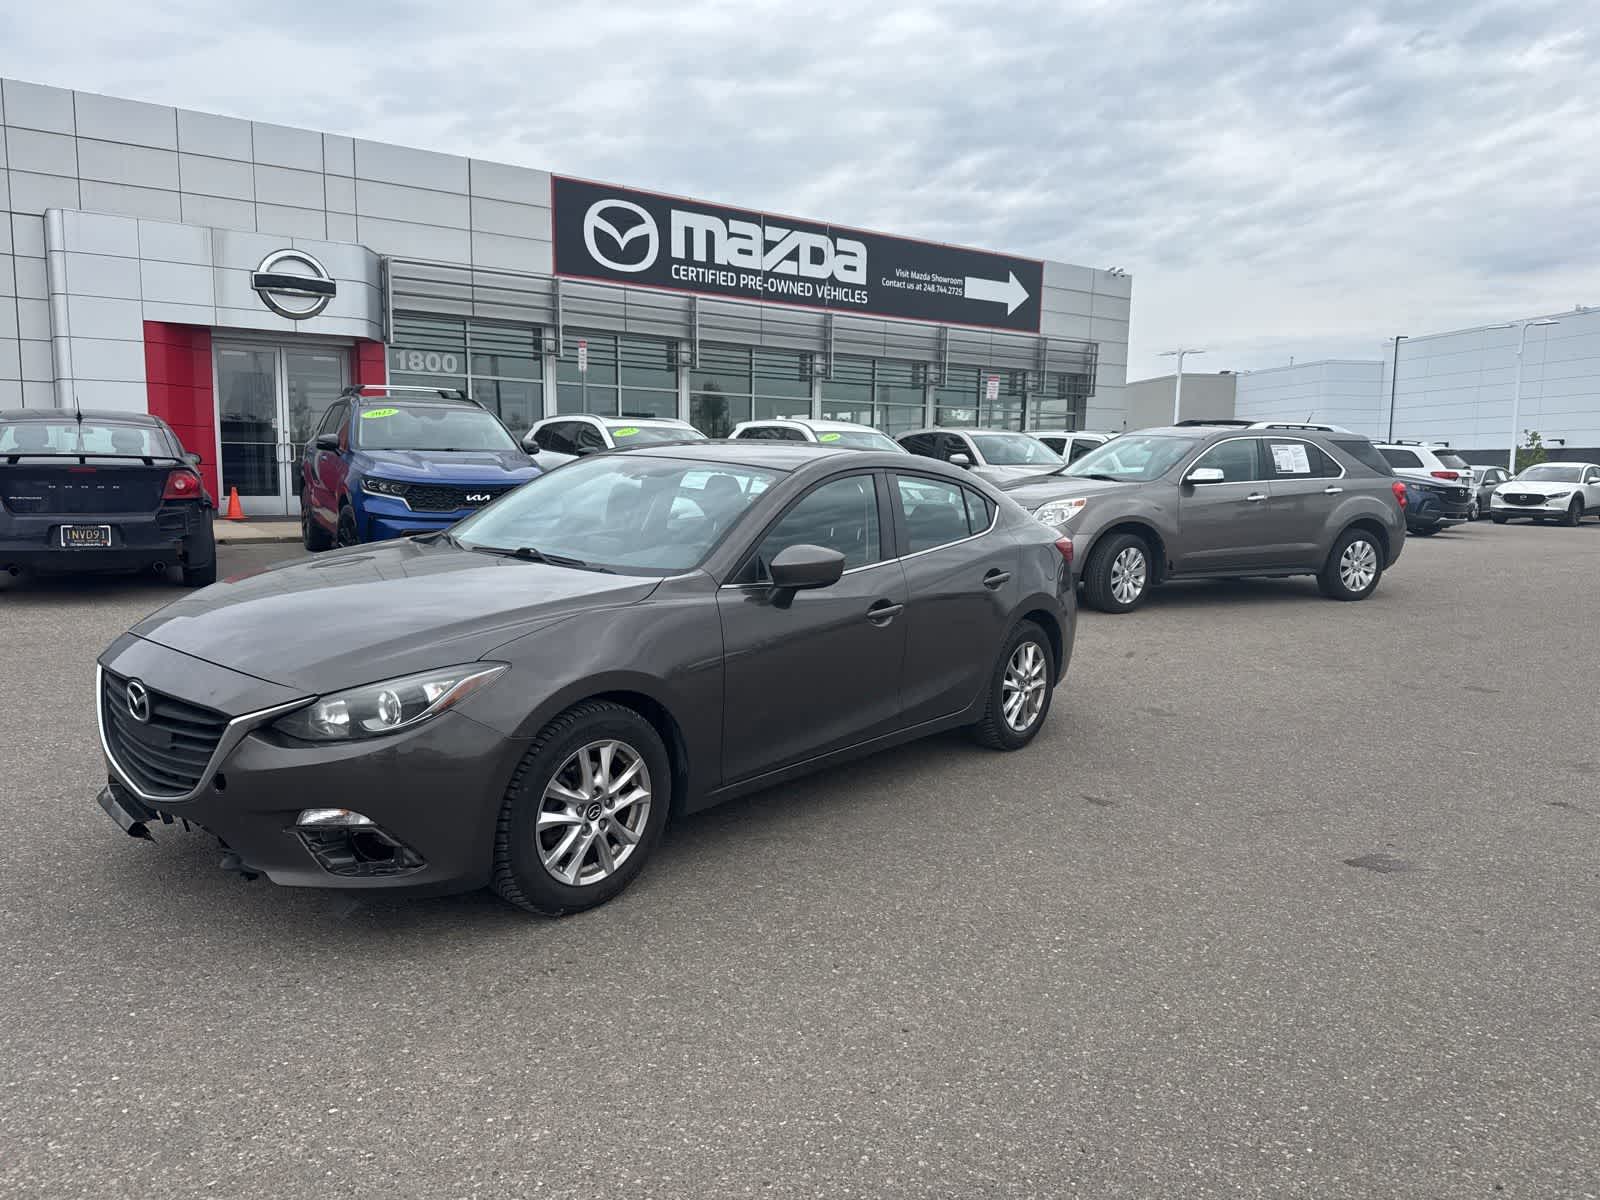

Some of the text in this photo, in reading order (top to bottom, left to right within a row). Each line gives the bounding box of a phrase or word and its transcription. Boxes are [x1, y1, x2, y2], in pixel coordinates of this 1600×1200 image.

[671, 265, 868, 304] CERTIFIED PRE-OWNED VEHICLES
[881, 277, 906, 289] Contact
[916, 283, 923, 291] at
[895, 268, 963, 285] Visit Mazda Showroom
[395, 350, 457, 373] 1800
